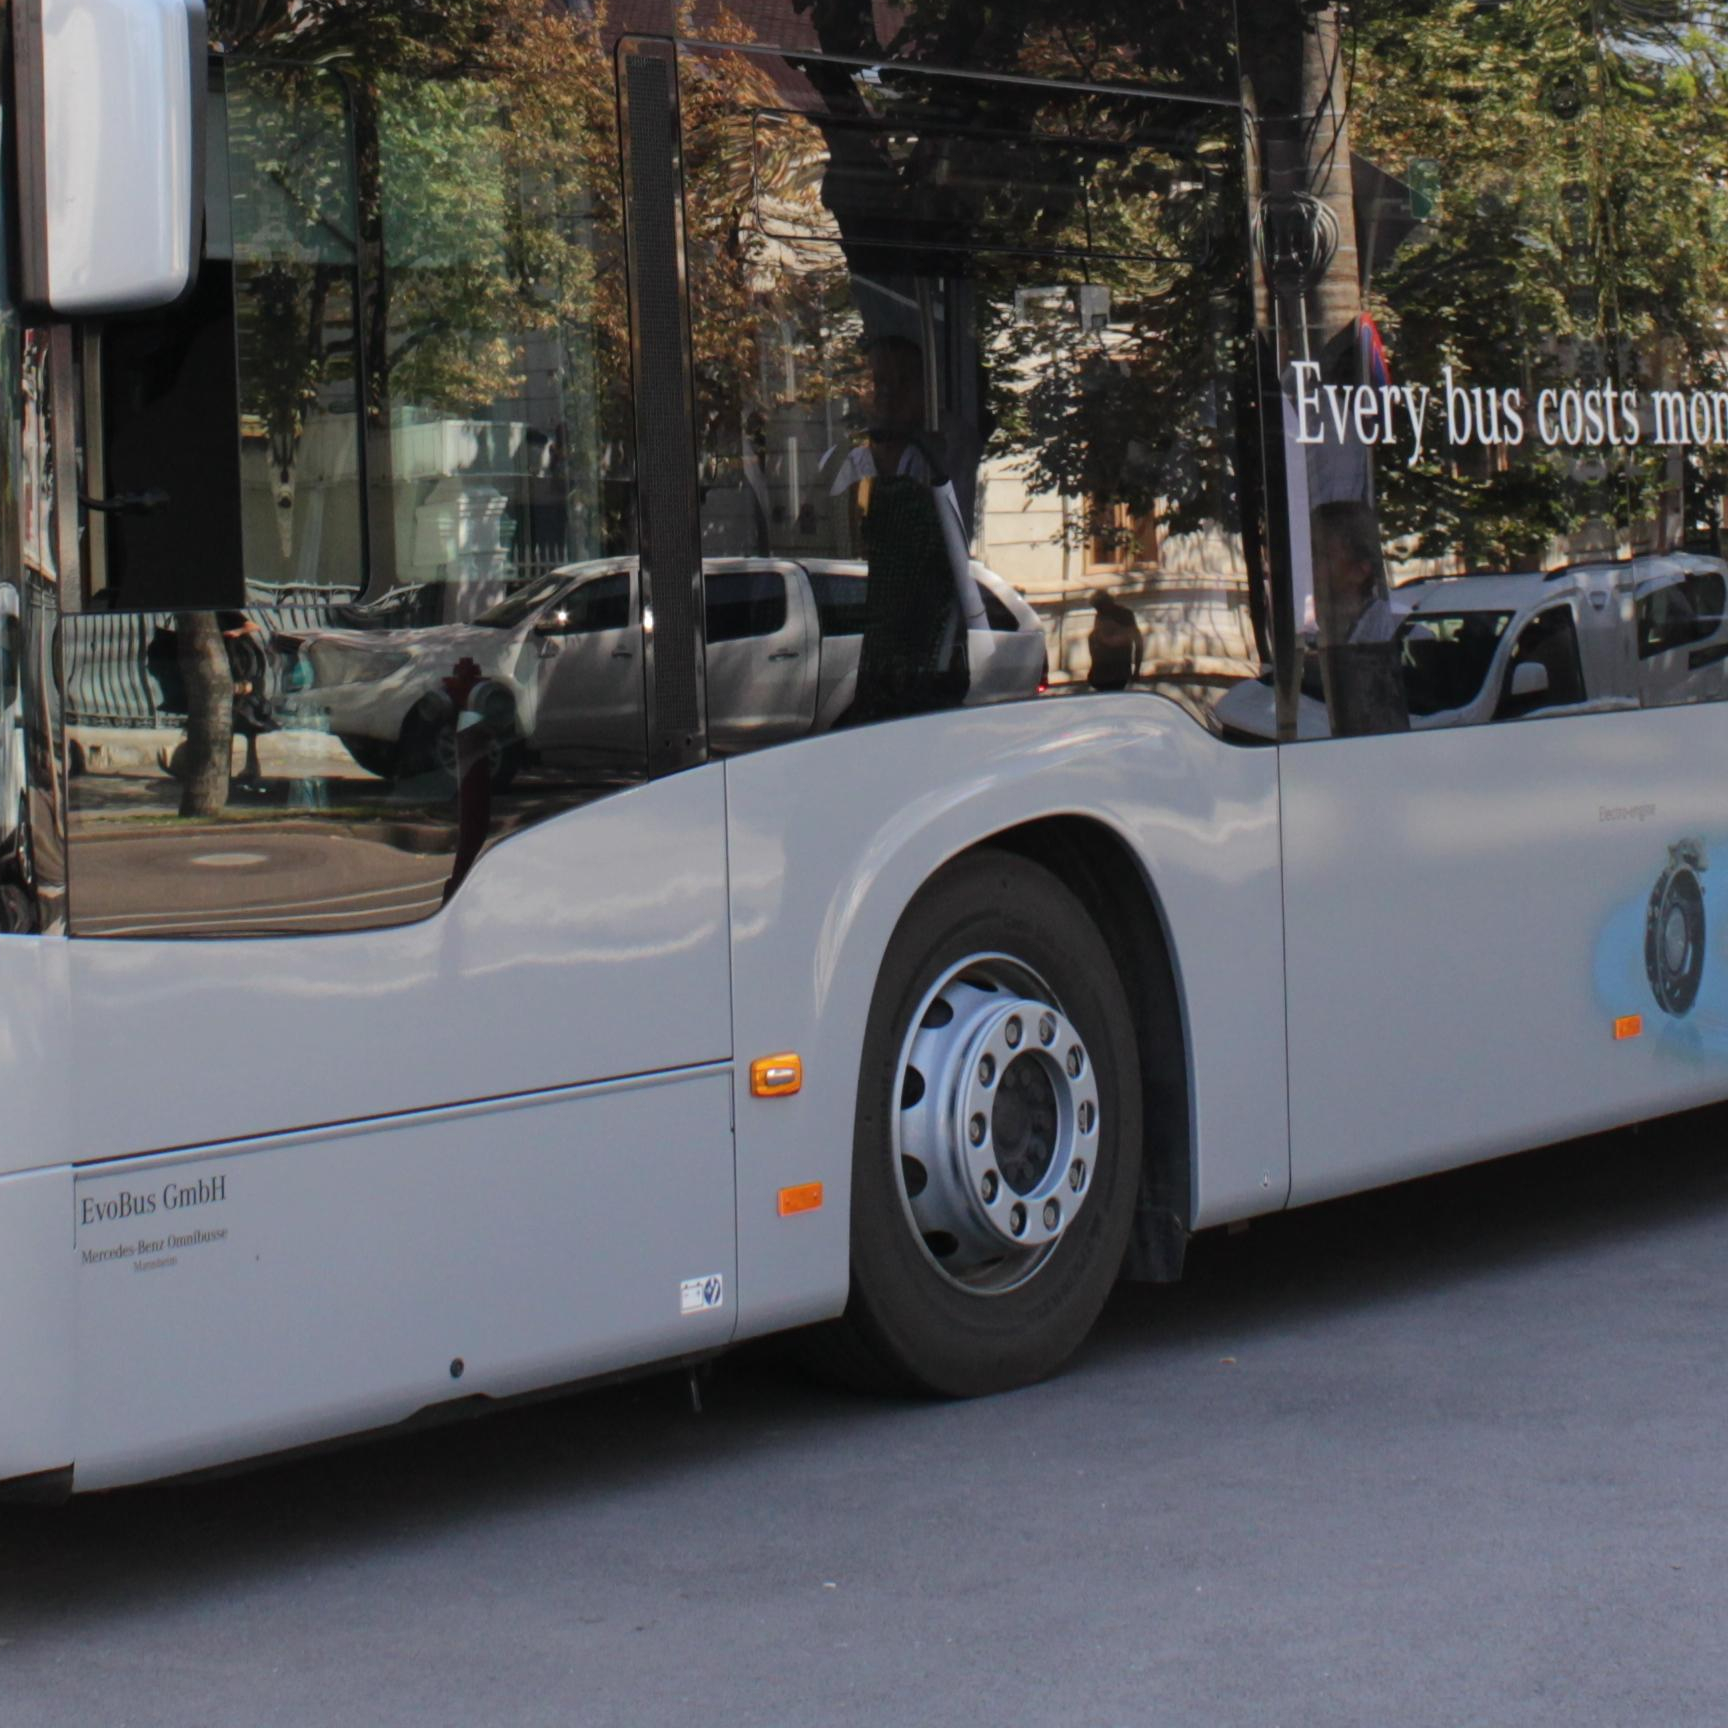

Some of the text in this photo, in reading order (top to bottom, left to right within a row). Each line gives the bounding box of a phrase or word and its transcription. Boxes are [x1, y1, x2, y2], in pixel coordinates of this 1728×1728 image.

[1290, 360, 1430, 467] Every
[1444, 364, 1524, 446] bus
[1538, 376, 1640, 446] costs
[80, 1174, 227, 1226] EvoBus GmbH
